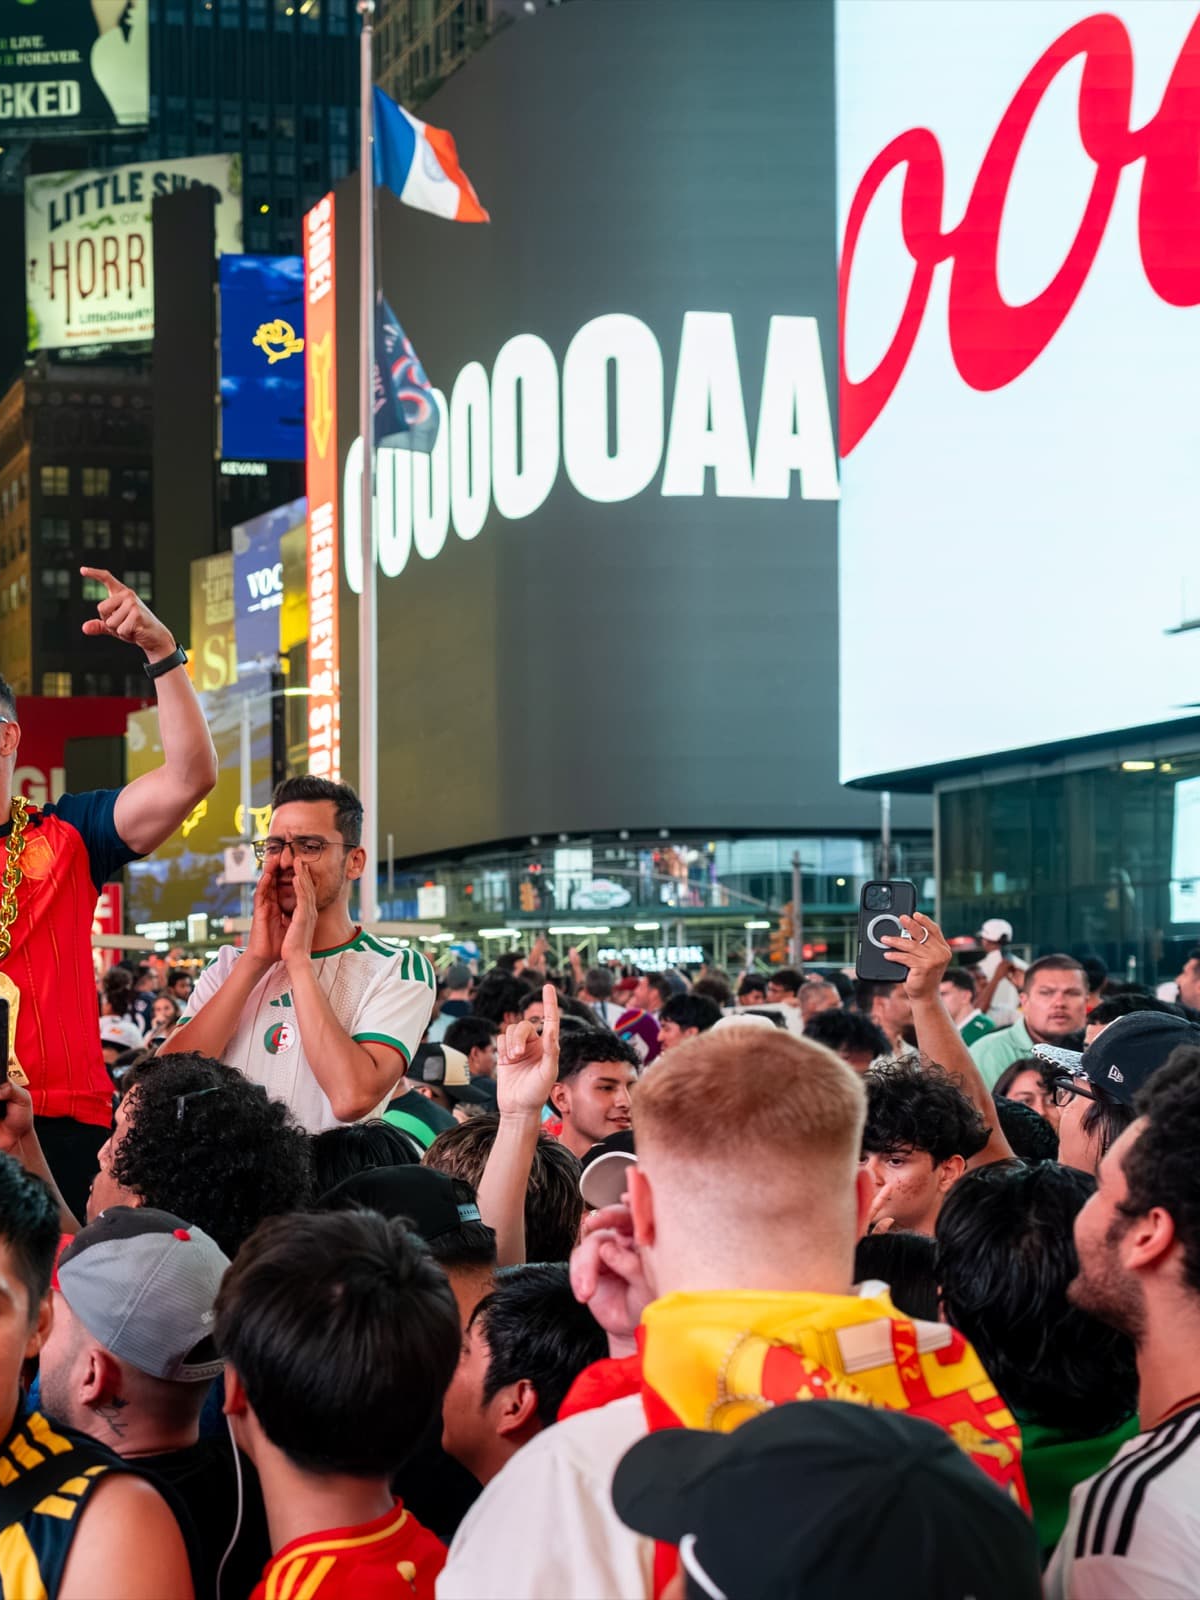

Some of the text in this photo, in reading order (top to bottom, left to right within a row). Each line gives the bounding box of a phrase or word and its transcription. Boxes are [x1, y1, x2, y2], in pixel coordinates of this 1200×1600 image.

[50, 171, 144, 232] LITTLE
[308, 501, 335, 784] HERSHEY'S STO
